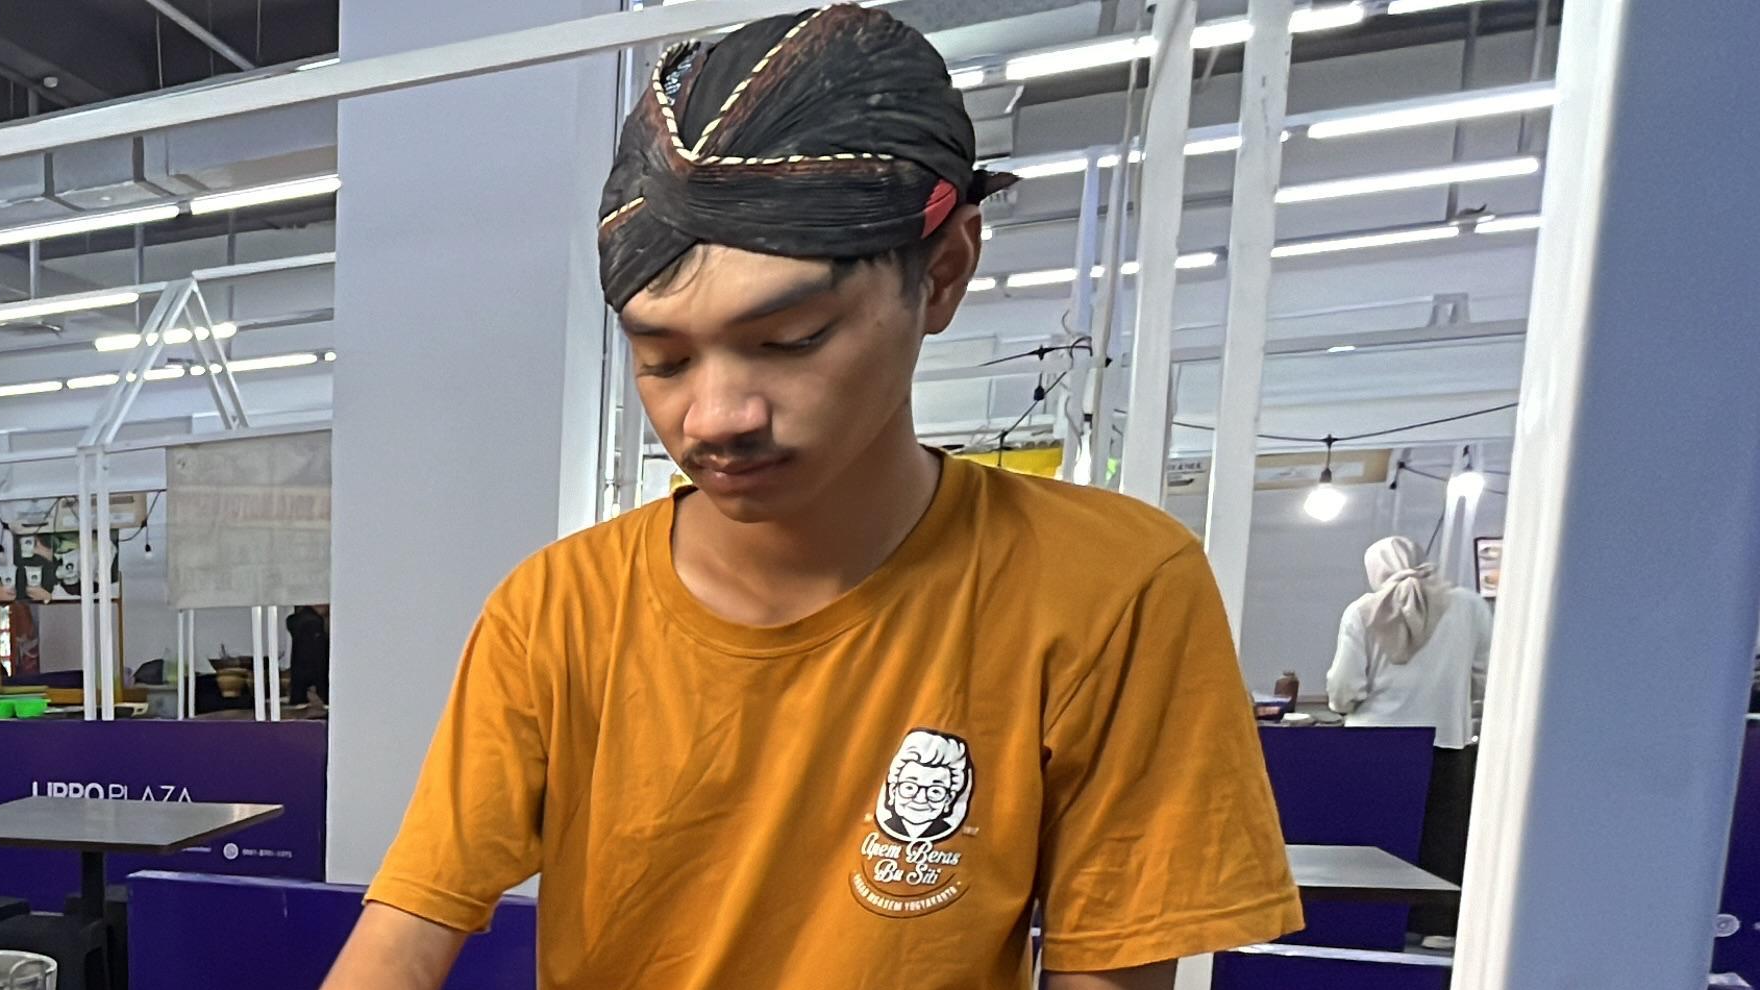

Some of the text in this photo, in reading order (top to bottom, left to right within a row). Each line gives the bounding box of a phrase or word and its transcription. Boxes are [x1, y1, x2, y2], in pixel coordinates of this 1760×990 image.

[905, 840, 961, 866] Beras
[873, 858, 942, 886] Bu Siti
